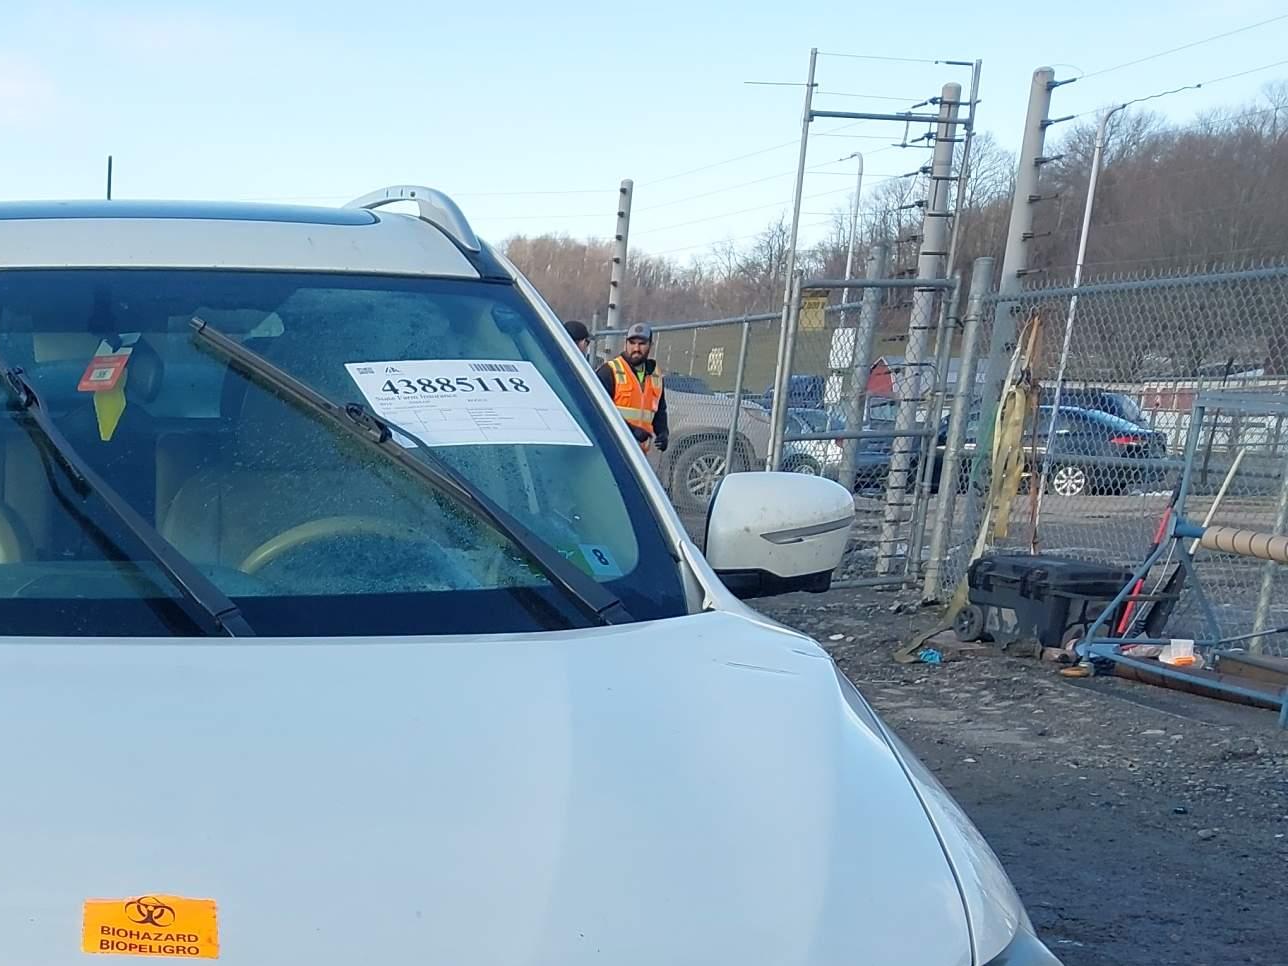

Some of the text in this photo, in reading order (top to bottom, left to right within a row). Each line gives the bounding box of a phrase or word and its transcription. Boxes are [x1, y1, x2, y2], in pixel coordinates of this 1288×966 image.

[381, 377, 530, 394] 43885118
[592, 549, 609, 565] 8
[100, 925, 199, 943] BIOHAZARD
[99, 939, 200, 956] BIOPELIGRO
